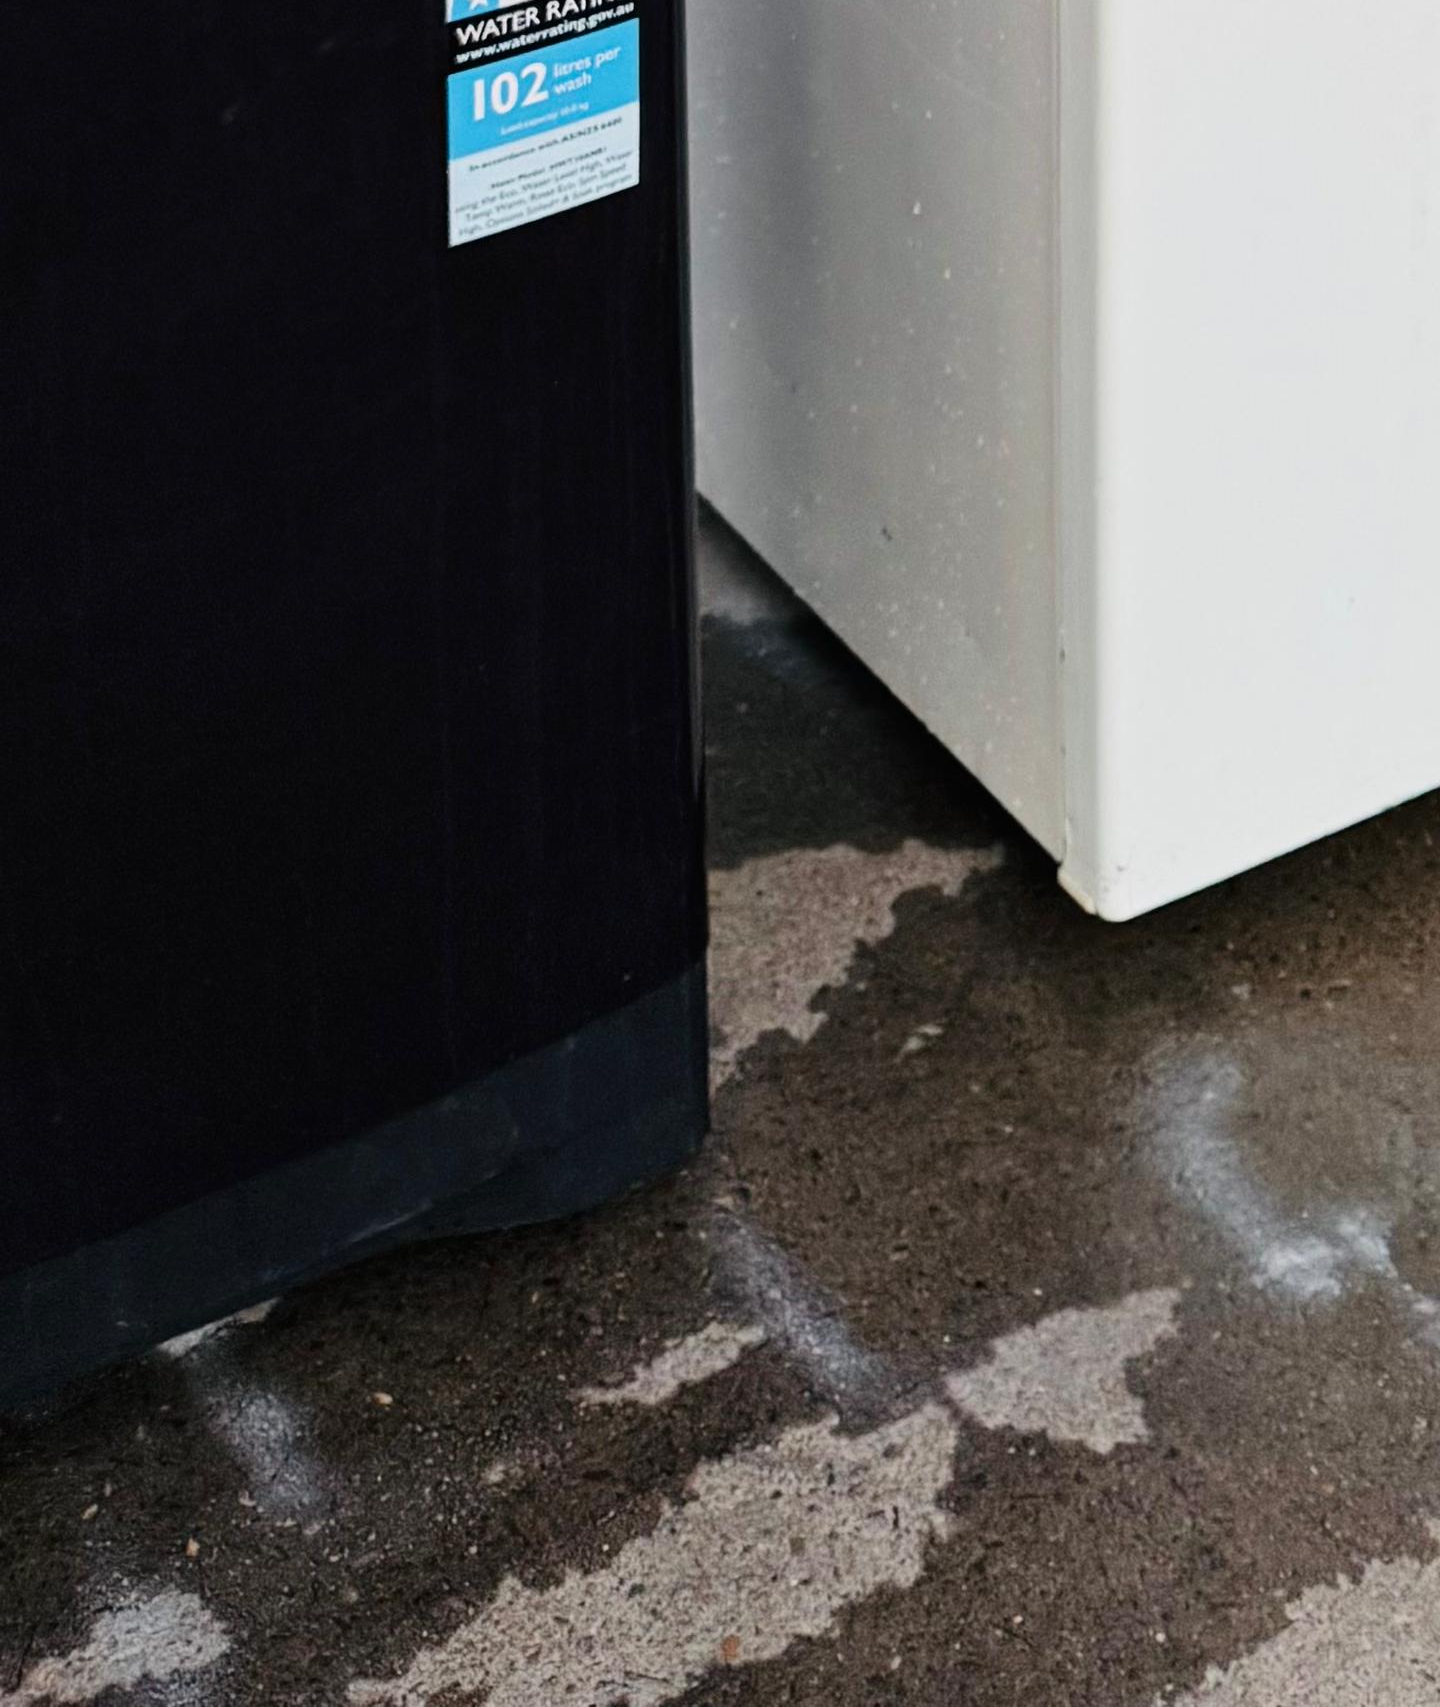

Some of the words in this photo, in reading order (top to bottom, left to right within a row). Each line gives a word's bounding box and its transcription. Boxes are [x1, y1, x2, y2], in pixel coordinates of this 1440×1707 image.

[454, 2, 635, 65] www.waterrating.gov.au
[455, 7, 541, 45] WATER
[473, 62, 549, 123] 102
[552, 56, 592, 78] litres
[594, 46, 622, 68] per
[552, 72, 593, 95] wash
